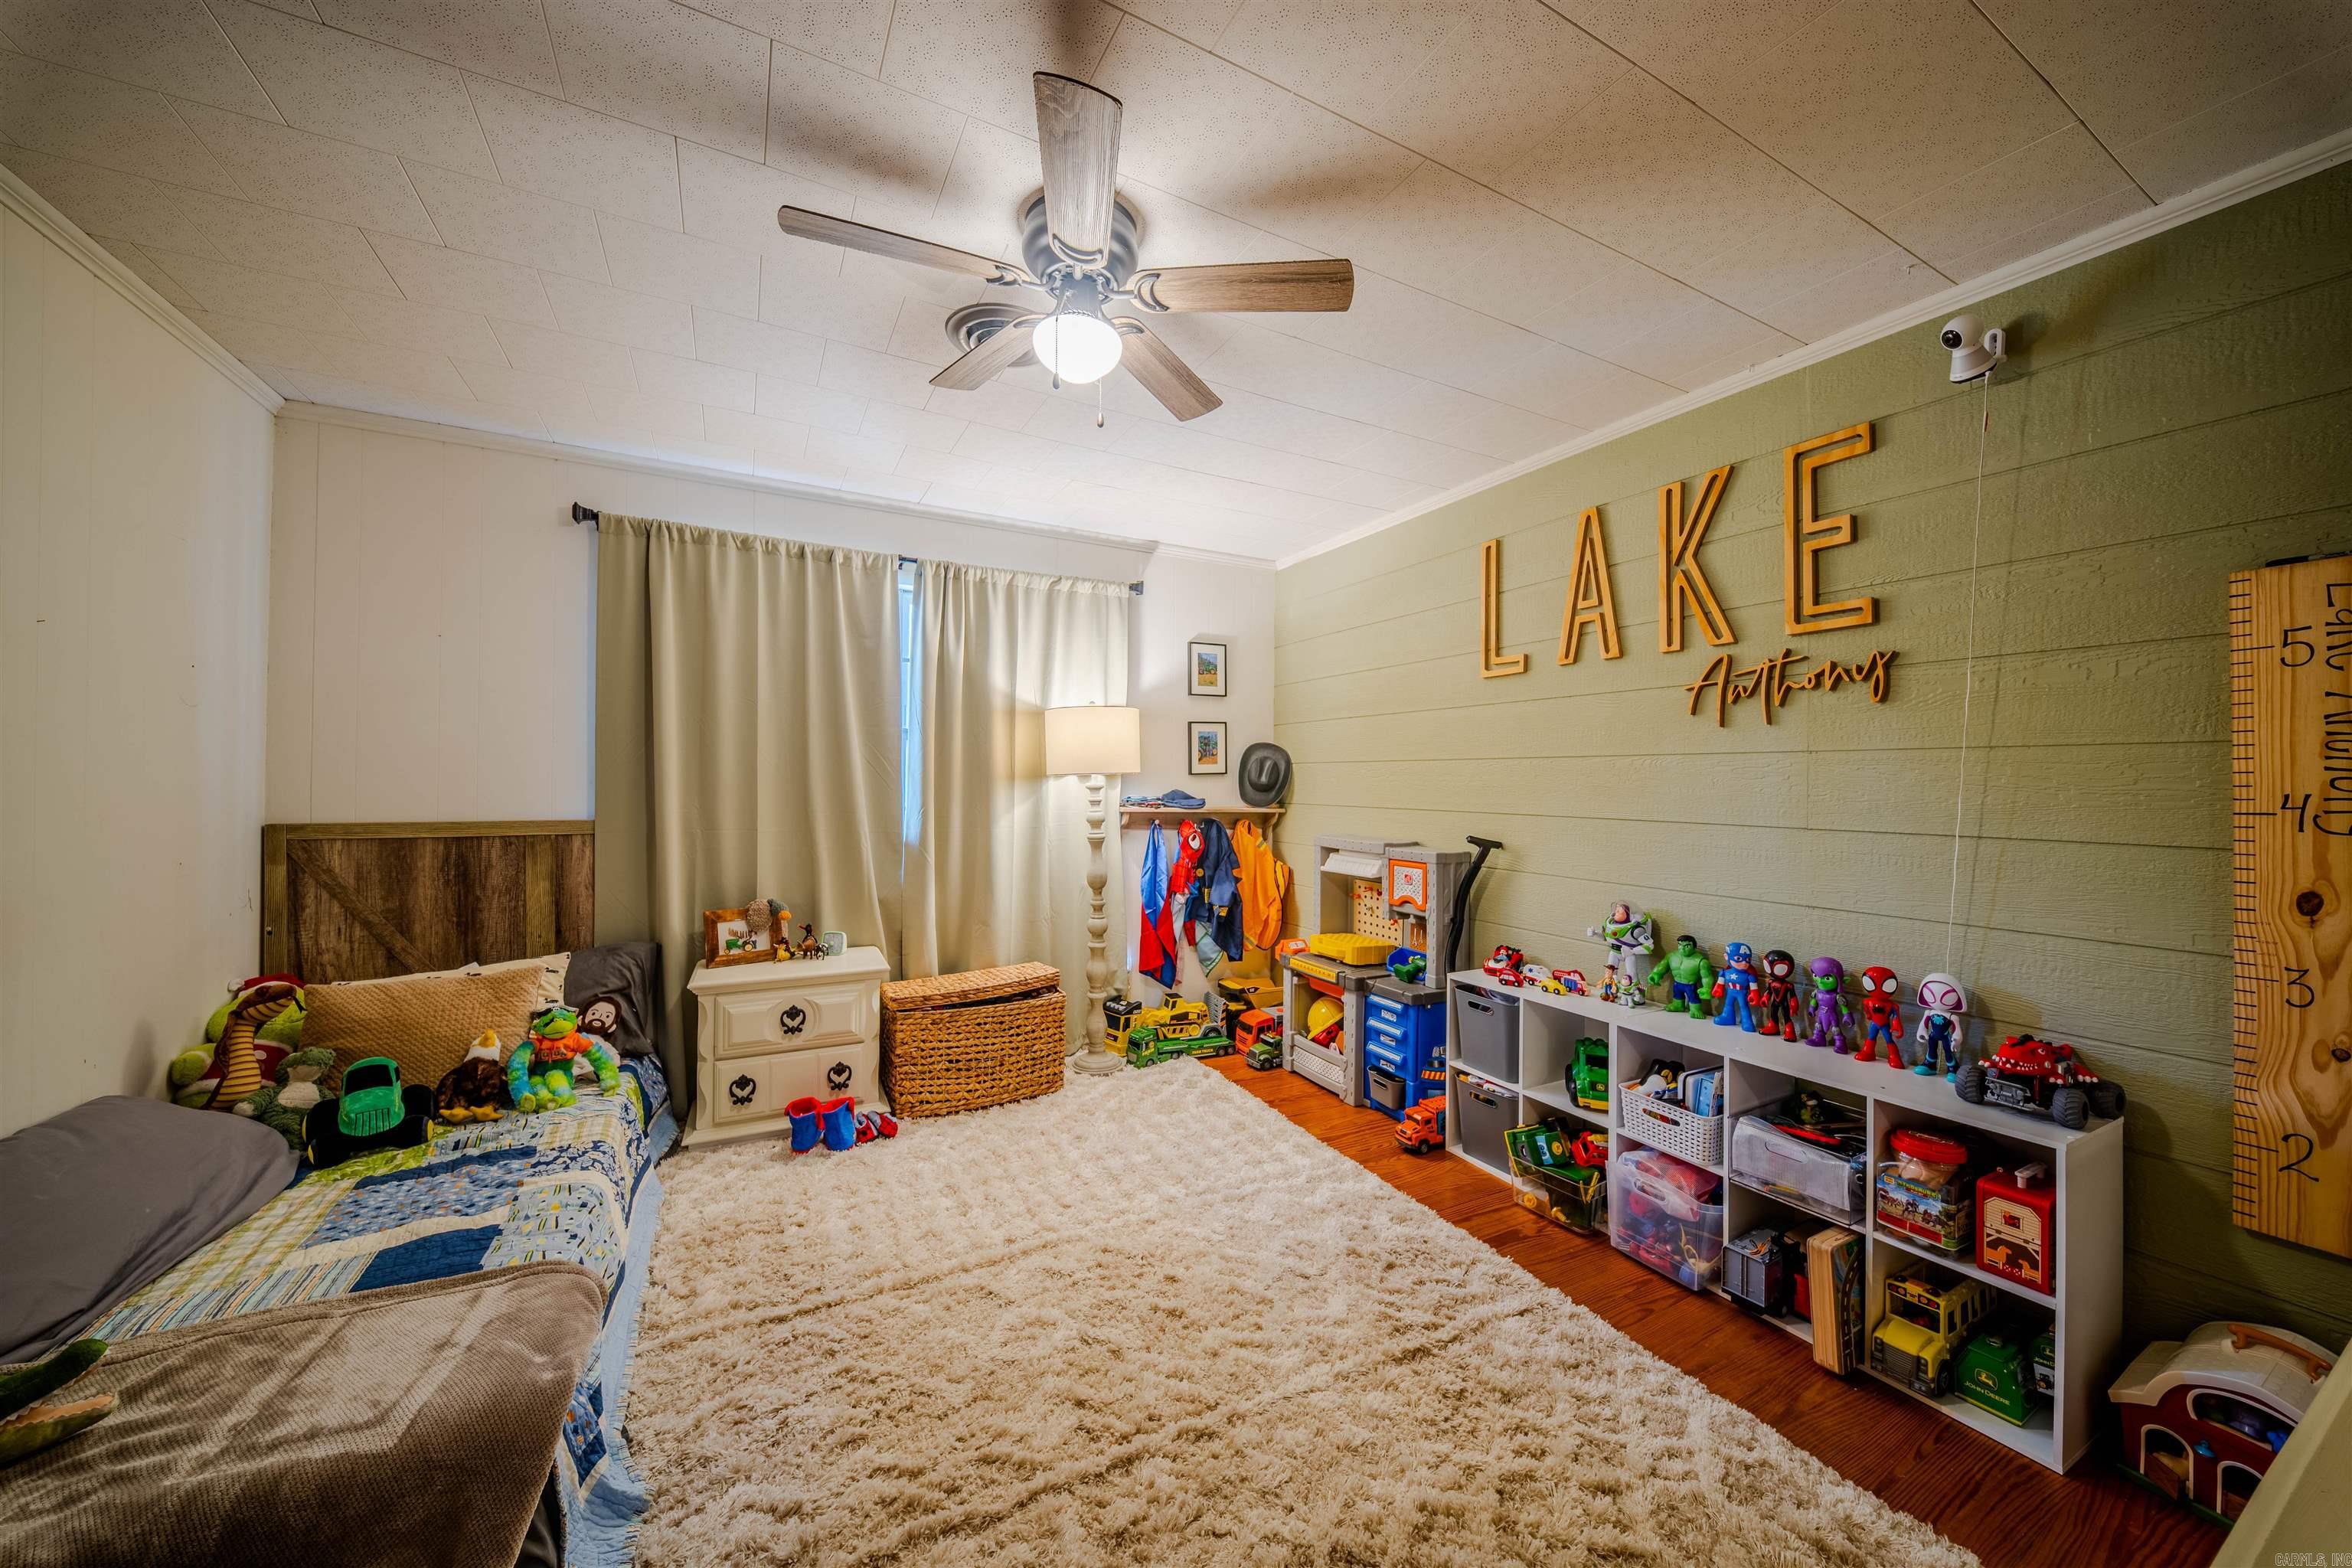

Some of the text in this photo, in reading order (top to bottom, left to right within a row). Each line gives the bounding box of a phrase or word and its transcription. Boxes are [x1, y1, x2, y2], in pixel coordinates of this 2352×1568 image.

[1482, 421, 1878, 679] LAKE
[2280, 625, 2315, 668] 5
[1686, 648, 1899, 728] Anthony
[2280, 793, 2312, 833] 4
[2285, 966, 2315, 1008] 3
[2278, 1134, 2320, 1182] 2
[1963, 1381, 2011, 1406] JOHN DEERE
